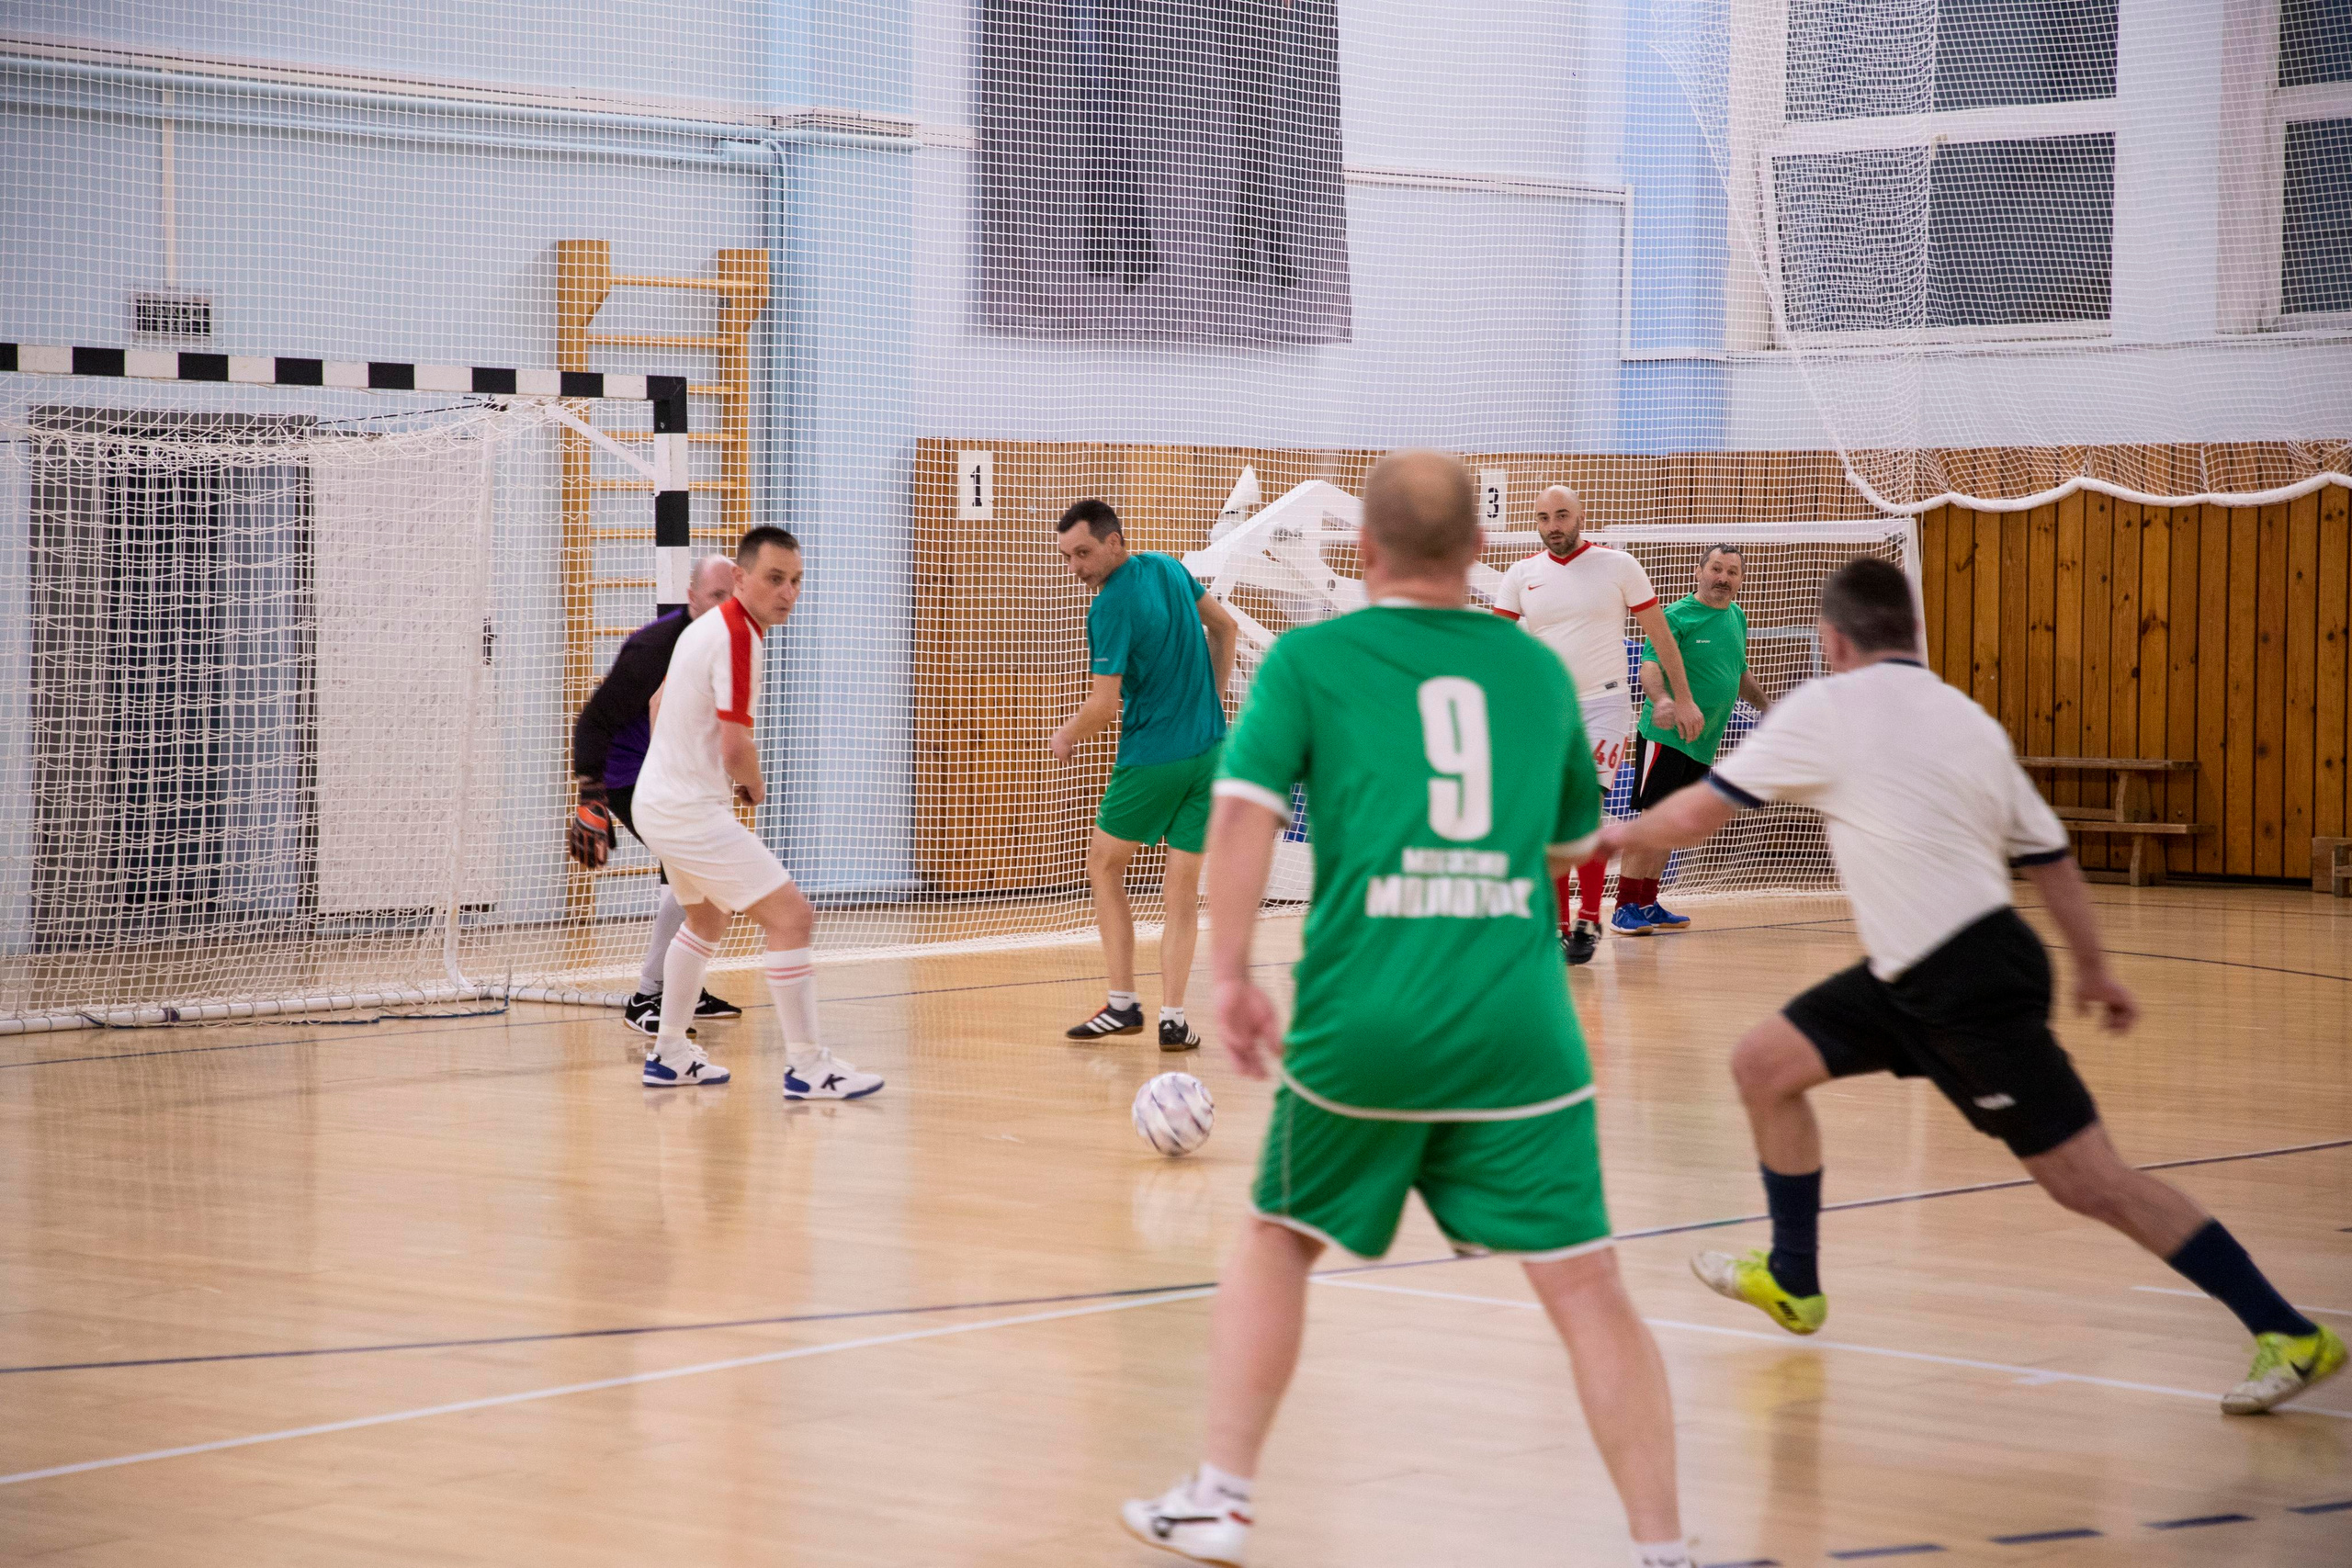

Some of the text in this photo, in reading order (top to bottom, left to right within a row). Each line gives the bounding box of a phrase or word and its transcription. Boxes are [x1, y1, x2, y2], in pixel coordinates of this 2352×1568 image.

[970, 465, 982, 506] 1
[1487, 487, 1498, 518] 3
[1418, 675, 1493, 841] 9
[1593, 739, 1620, 769] 46
